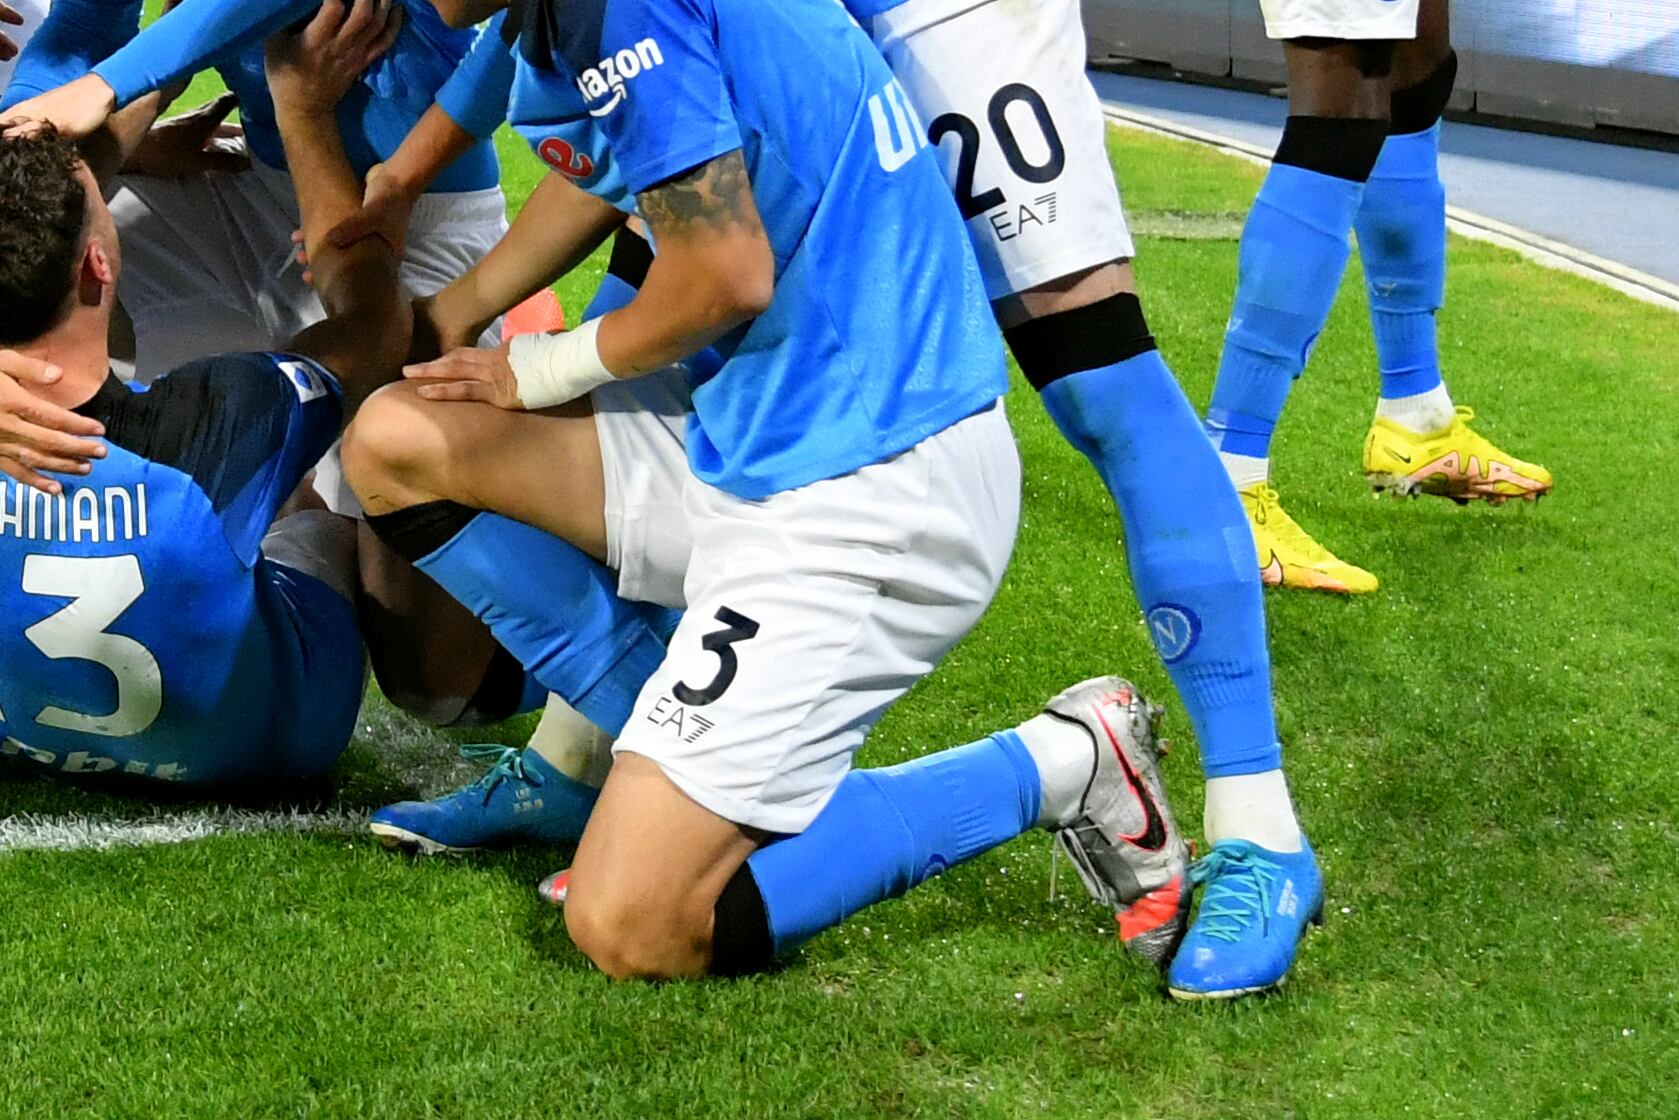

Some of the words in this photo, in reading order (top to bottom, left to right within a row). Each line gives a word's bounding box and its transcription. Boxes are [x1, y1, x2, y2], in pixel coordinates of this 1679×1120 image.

[927, 82, 1066, 222] 20
[989, 191, 1057, 243] EA7
[671, 605, 761, 707] 3
[646, 696, 716, 744] EA7
